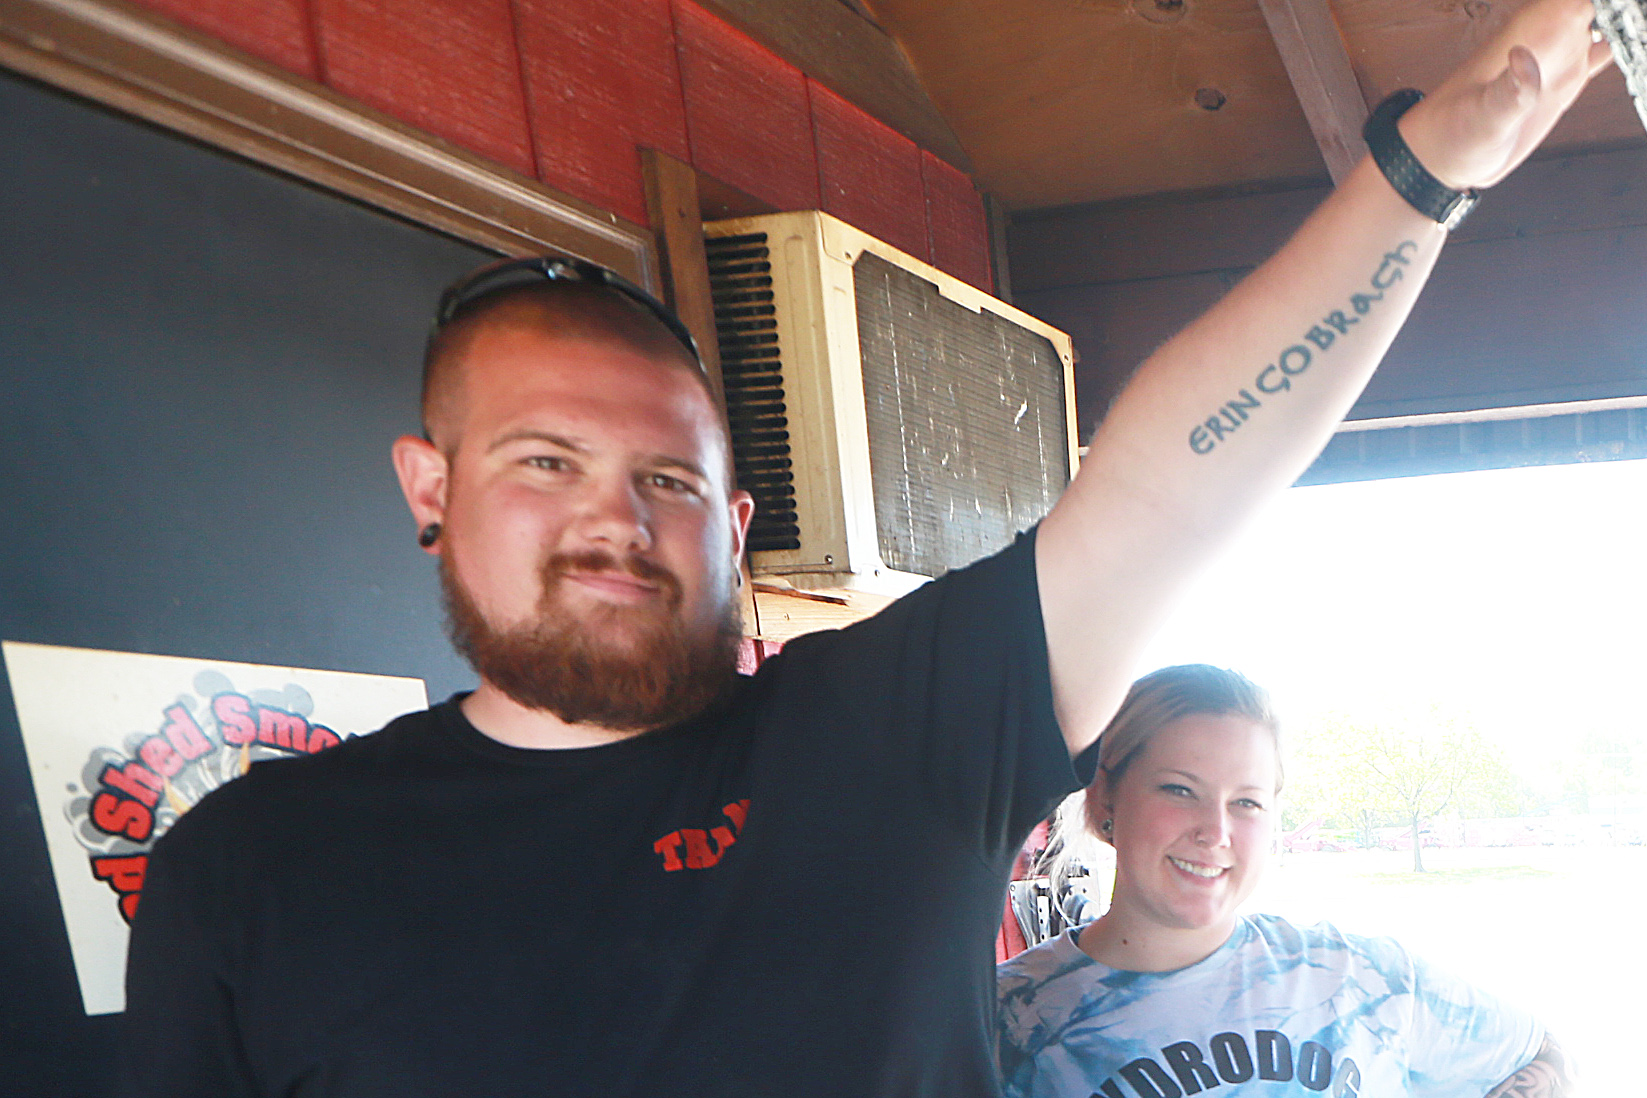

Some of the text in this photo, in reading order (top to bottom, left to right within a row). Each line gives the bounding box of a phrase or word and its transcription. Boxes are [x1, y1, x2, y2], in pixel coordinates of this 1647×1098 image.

[1188, 388, 1262, 455] ERIN
[90, 691, 345, 844] Shed Smo
